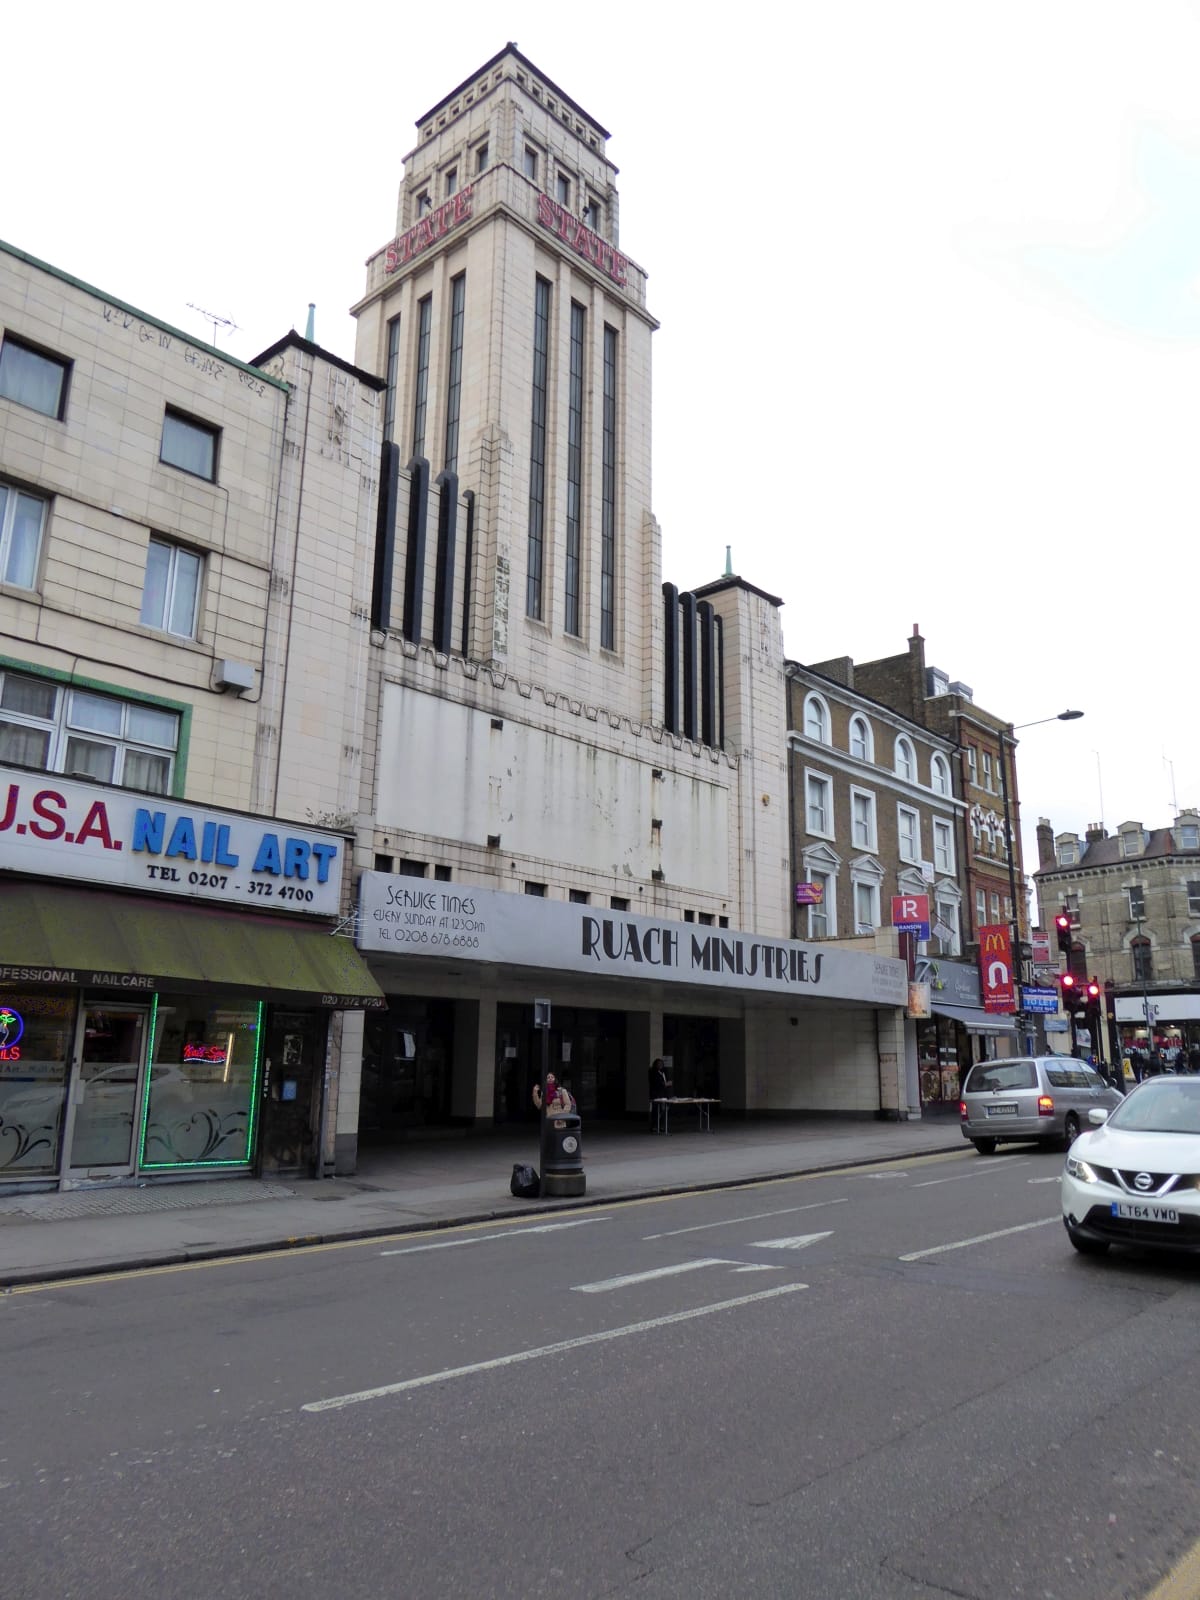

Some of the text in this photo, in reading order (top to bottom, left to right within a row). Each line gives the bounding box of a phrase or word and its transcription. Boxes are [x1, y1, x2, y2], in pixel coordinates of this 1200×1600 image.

[384, 184, 474, 273] STATE
[538, 192, 628, 288] STATE
[132, 808, 239, 868] NAIL
[252, 833, 337, 883] ART
[147, 864, 180, 882] TEL
[188, 871, 228, 890] 0207
[248, 881, 273, 897] 372
[279, 886, 314, 902] 4700
[386, 885, 476, 915] SERVICE TIMES
[902, 899, 919, 918] R
[373, 909, 401, 922] EVERY
[404, 912, 437, 926] SUNDAY
[439, 917, 449, 928] AT
[378, 928, 479, 948] TEL 0208 678 6888
[582, 915, 824, 984] RUACH MINISTRIES
[92, 973, 155, 988] NAILCARE
[1039, 999, 1054, 1007] LET
[1119, 1204, 1149, 1218] LT64
